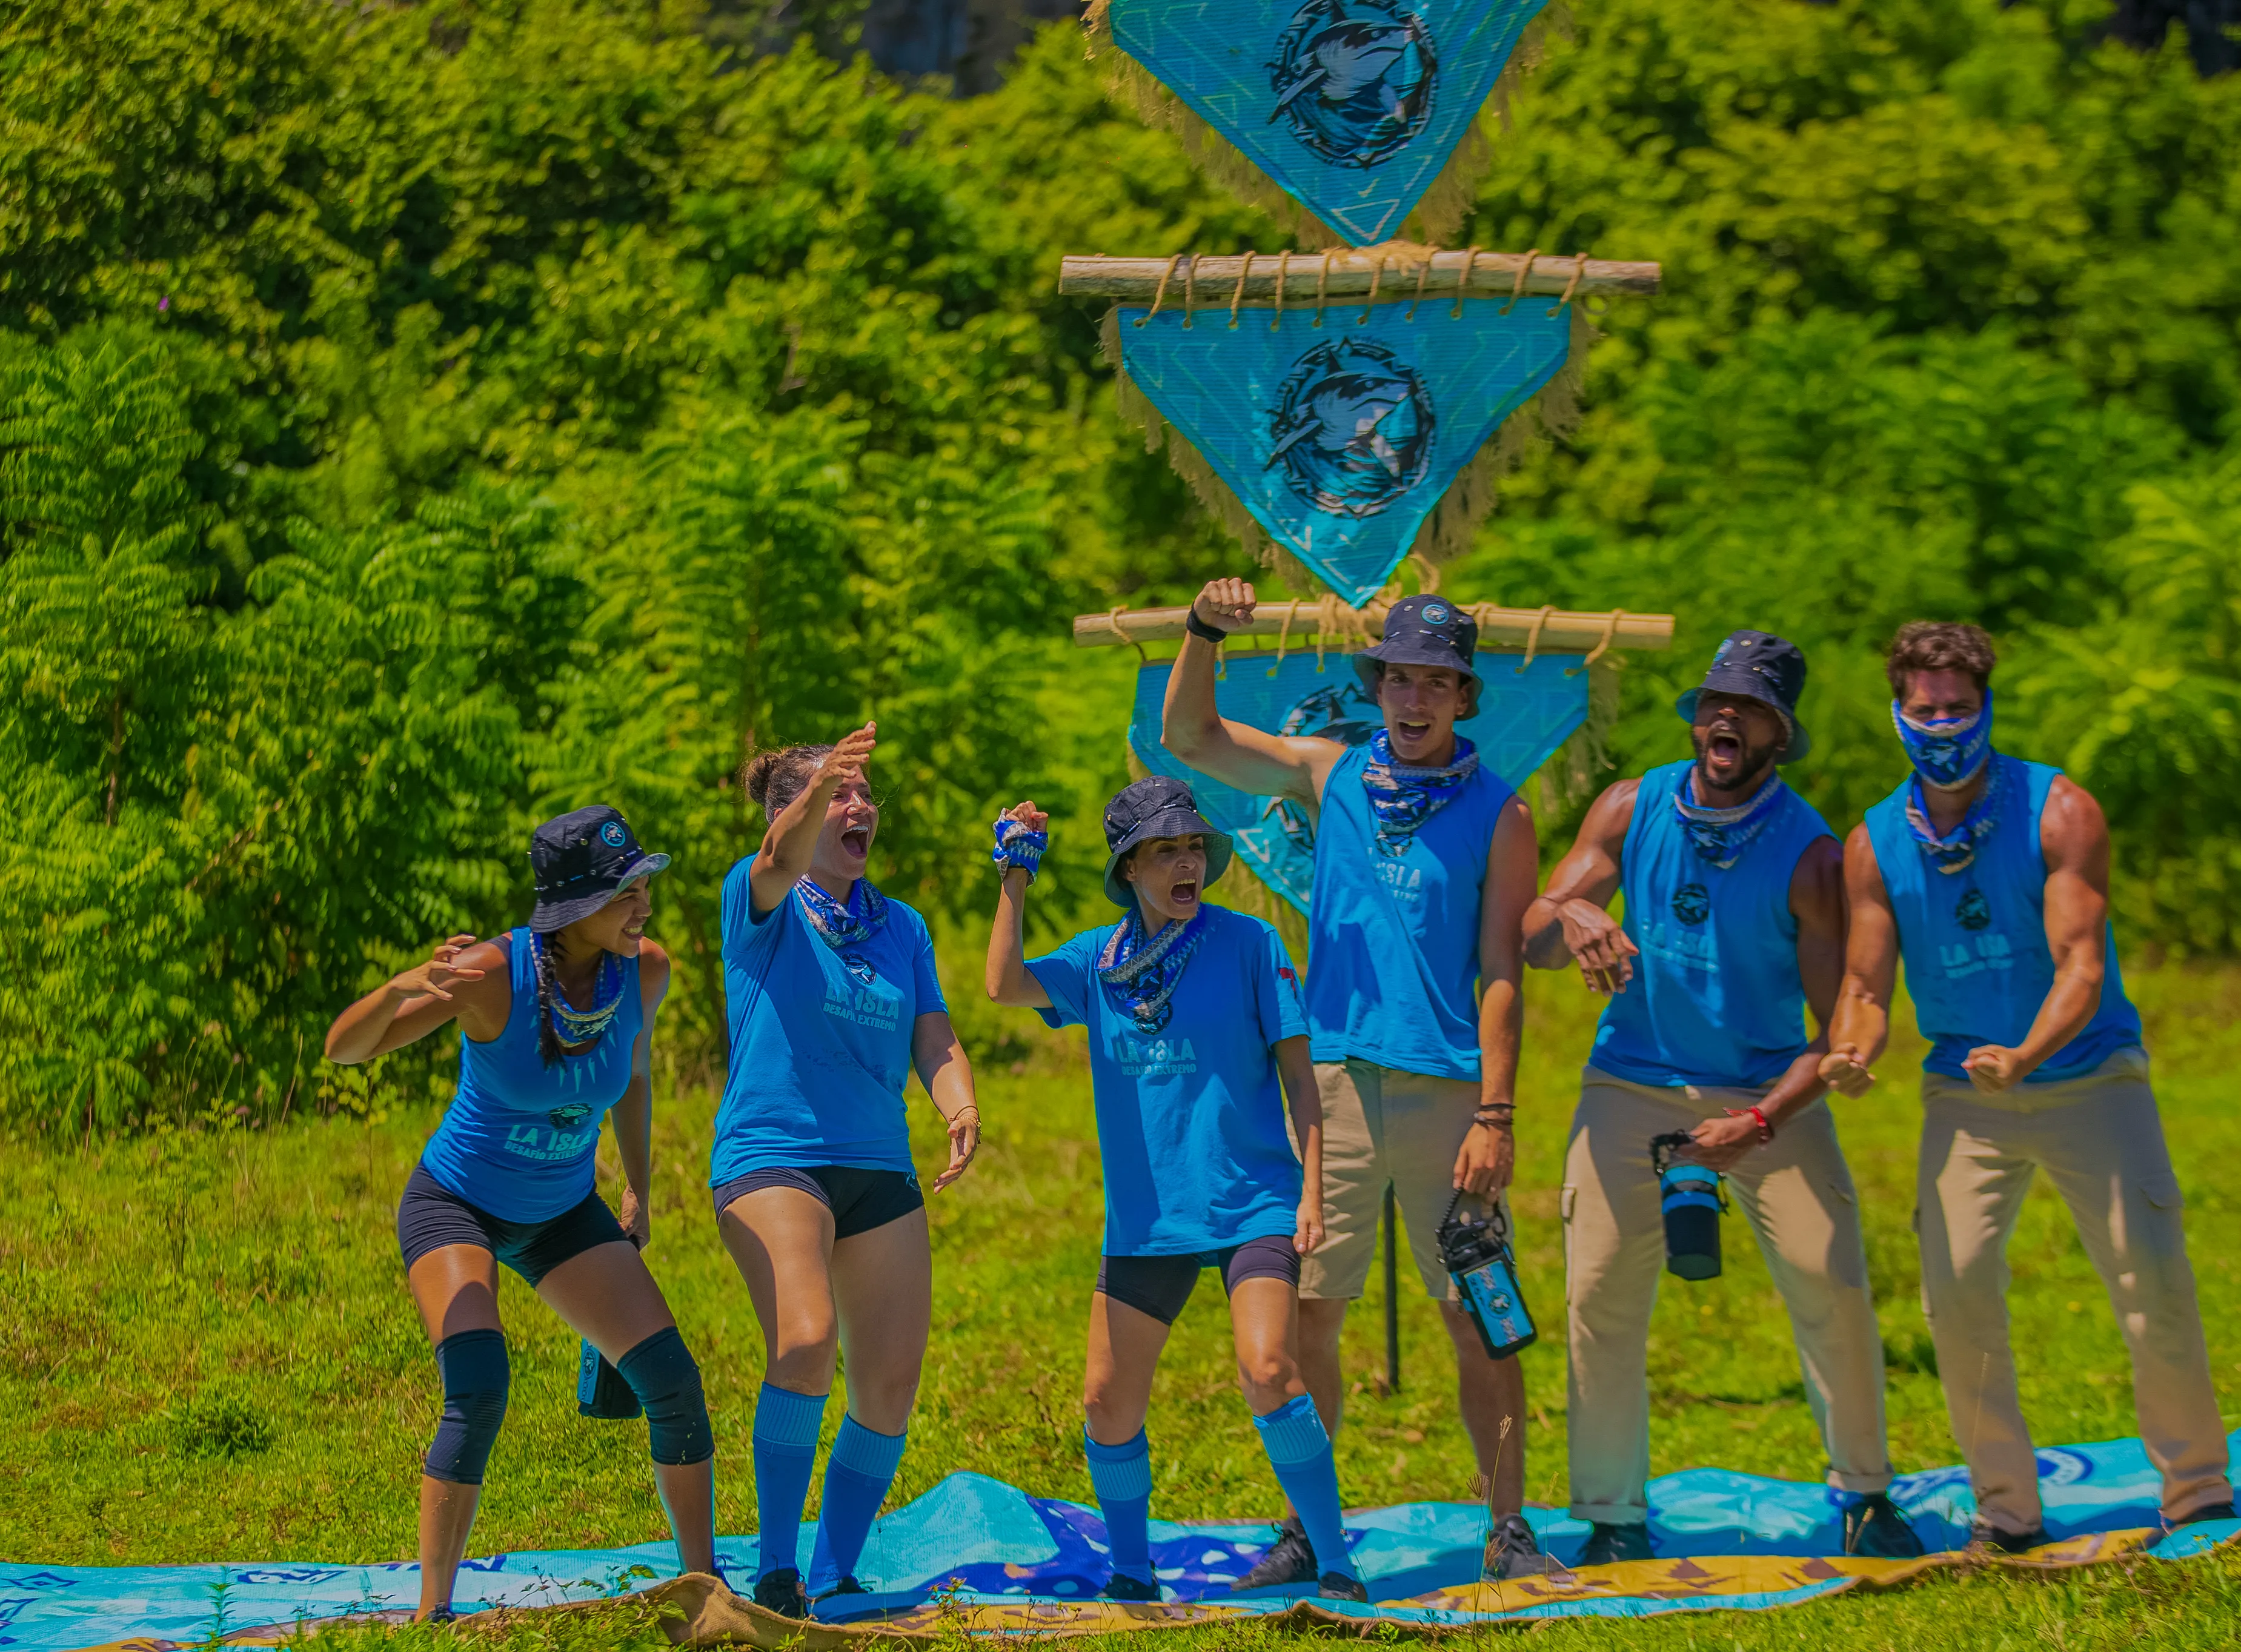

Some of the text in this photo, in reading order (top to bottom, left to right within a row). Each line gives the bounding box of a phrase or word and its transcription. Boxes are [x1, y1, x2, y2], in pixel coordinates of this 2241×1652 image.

[825, 985, 899, 1020] LA ISLA
[857, 1014, 896, 1032] EXTREMO
[1115, 1038, 1197, 1063] LA ISLA
[1154, 1063, 1197, 1075] EXTREMO
[508, 1124, 593, 1152] LA ISLA
[503, 1140, 546, 1159] DESAFÍO
